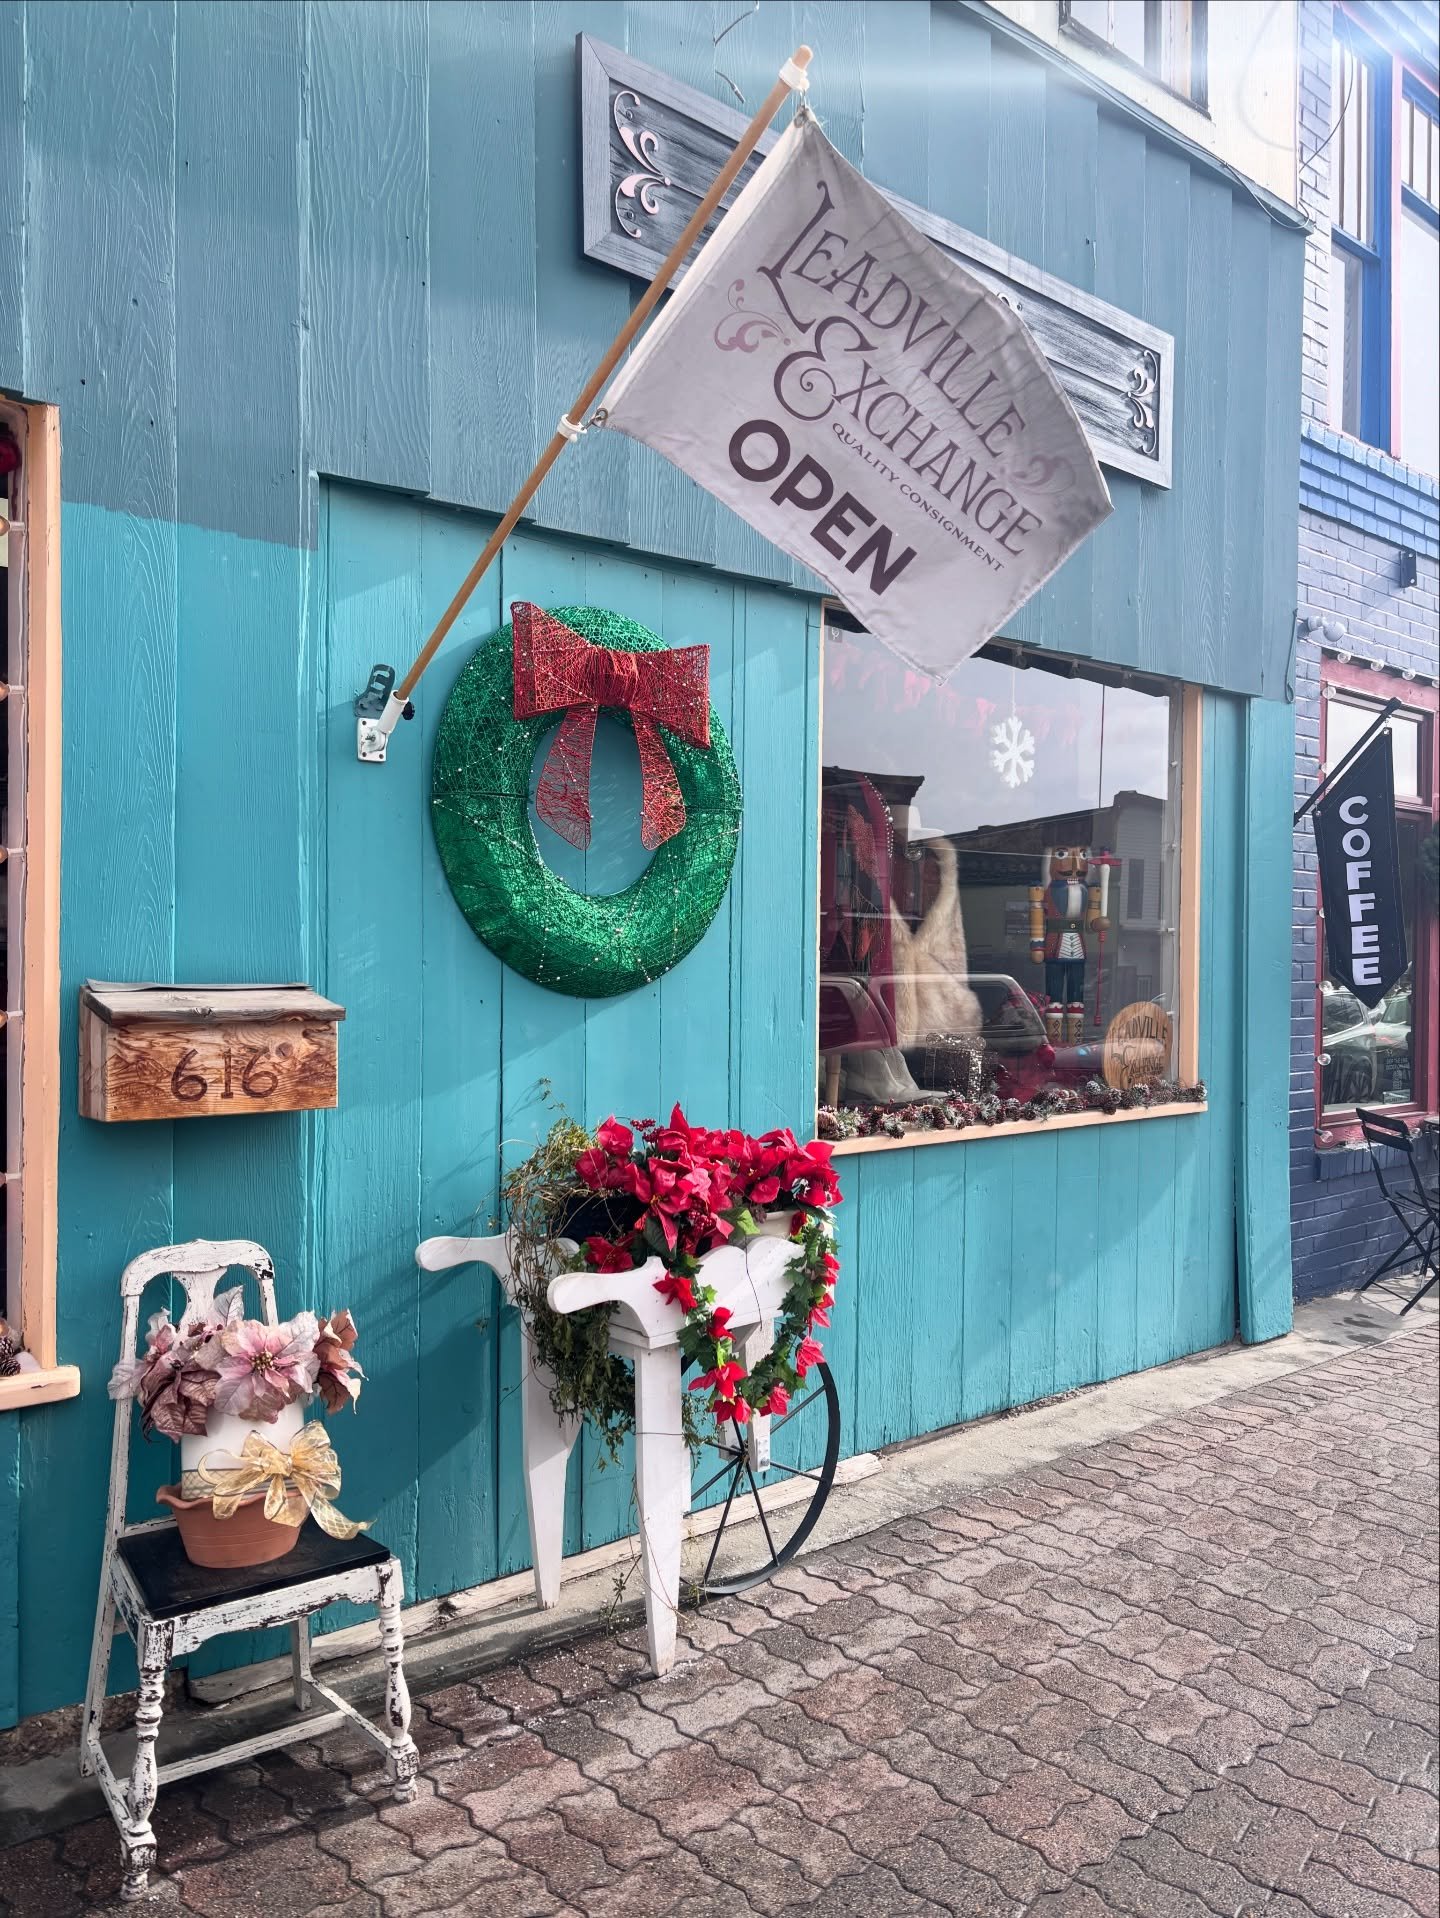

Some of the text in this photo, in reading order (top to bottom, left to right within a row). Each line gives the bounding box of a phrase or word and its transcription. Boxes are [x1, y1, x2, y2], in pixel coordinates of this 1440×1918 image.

[757, 180, 1025, 458] LEADVILLE
[728, 419, 917, 596] OPEN
[773, 316, 1043, 556] EXCHANGE
[832, 423, 1005, 572] QUALITY CONSIGNMENT
[1339, 795, 1382, 986] COFFEE
[171, 1048, 278, 1101] 616
